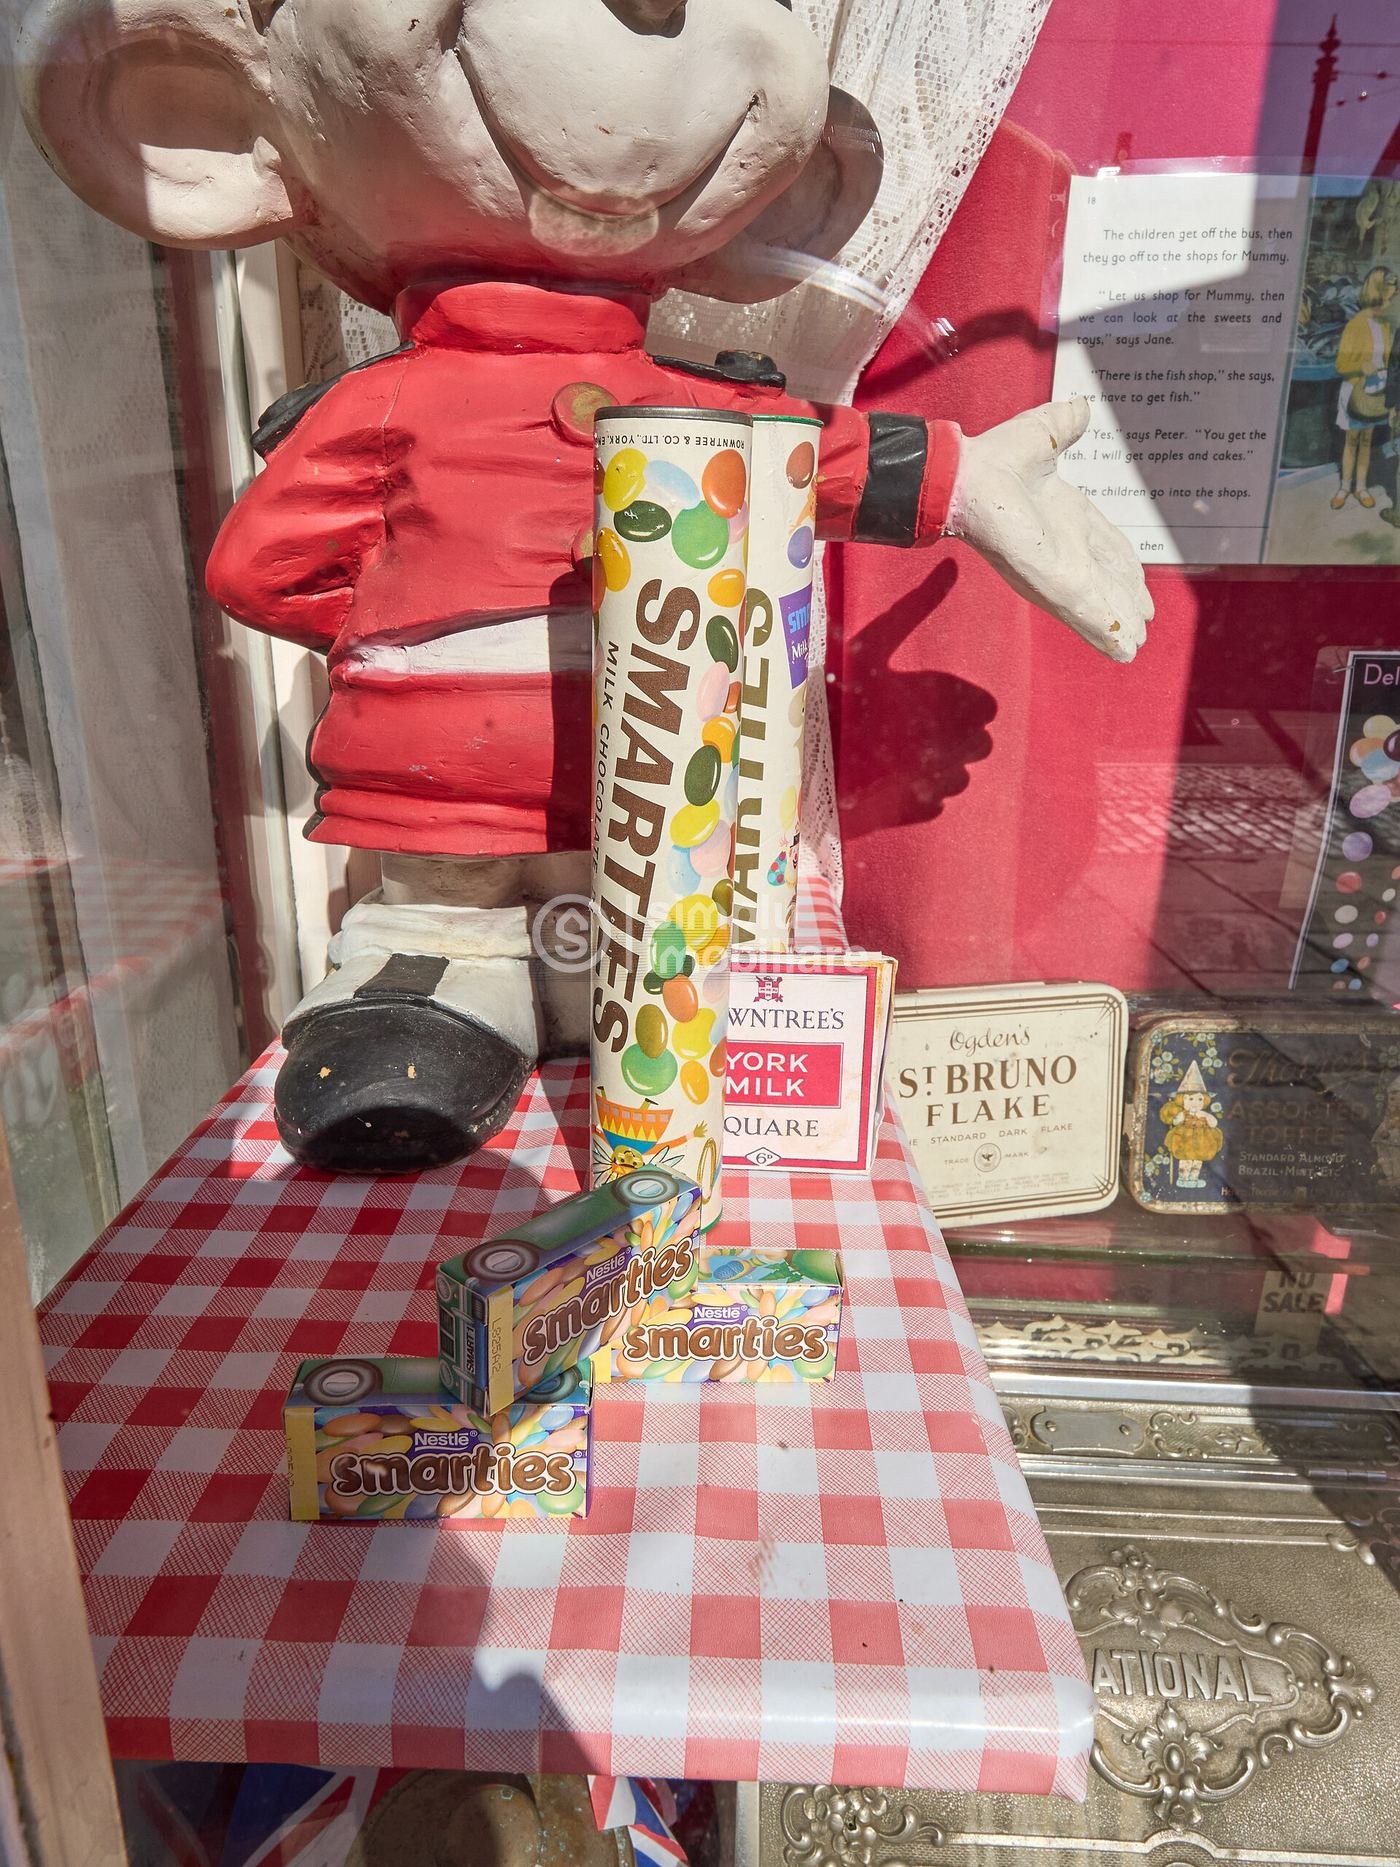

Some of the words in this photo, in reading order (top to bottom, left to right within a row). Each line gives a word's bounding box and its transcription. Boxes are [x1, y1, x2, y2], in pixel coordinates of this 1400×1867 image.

[1104, 230, 1124, 240] The
[1129, 230, 1174, 240] children
[1179, 230, 1197, 241] get
[1202, 228, 1217, 239] off
[1220, 228, 1236, 239] the
[1268, 229, 1292, 239] then
[1084, 253, 1108, 264] they
[1112, 254, 1125, 265] go
[1130, 251, 1145, 262] off
[1147, 253, 1159, 262] to
[1163, 251, 1180, 261] the
[1187, 251, 1218, 264] shops
[1222, 250, 1237, 261] for
[1242, 250, 1289, 265] Mummy.
[1134, 292, 1145, 301] us
[1153, 291, 1179, 304] shop
[1185, 289, 1200, 301] for
[1261, 291, 1285, 301] then
[1079, 314, 1094, 323] we
[1104, 314, 1123, 323] can
[1133, 312, 1157, 323] look
[1167, 313, 1178, 323] at
[1188, 312, 1205, 323] the
[1214, 313, 1251, 323] sweets
[1262, 312, 1282, 323] and
[1116, 337, 1139, 348] says
[1144, 335, 1174, 345] Jane.
[1134, 371, 1142, 381] is
[1146, 370, 1163, 381] the
[1166, 370, 1185, 381] fish
[1227, 371, 1245, 381] she
[1101, 393, 1126, 402] have
[1131, 393, 1142, 402] to
[1147, 394, 1164, 405] get
[661, 434, 680, 445] CO.
[684, 435, 691, 445] &
[695, 436, 745, 450] ROWNTREE
[1127, 431, 1150, 442] says
[1155, 429, 1187, 440] Peter.
[1229, 430, 1246, 442] get
[1250, 429, 1266, 440] the
[1064, 451, 1086, 460] fish.
[1093, 451, 1097, 460] I
[1102, 451, 1121, 460] will
[1125, 452, 1144, 463] get
[1148, 451, 1185, 463] apples
[1188, 451, 1208, 461] and
[1078, 486, 1096, 496] The
[1102, 486, 1146, 497] children
[1151, 489, 1164, 500] go
[1169, 487, 1191, 497] into
[1196, 487, 1213, 497] the
[1218, 487, 1250, 500] shops.
[1140, 541, 1164, 551] then
[603, 640, 620, 710] MILK
[1364, 663, 1400, 686] Del
[592, 578, 702, 1054] SMARTIES
[728, 1008, 845, 1030] WNTREE'S
[949, 1023, 1031, 1057] Ogden's
[727, 1051, 808, 1073] YORK
[946, 1054, 1077, 1095] BRUNO
[726, 1076, 805, 1097] MILK
[926, 1094, 1051, 1127] FLAKE
[724, 1116, 819, 1137] QUARE
[930, 1131, 987, 1145] STANDARD
[999, 1128, 1028, 1138] DARK
[1041, 1122, 1073, 1133] FLAKE
[1005, 1151, 1030, 1159] MARK
[1240, 1151, 1295, 1162] STANDARD
[523, 1237, 693, 1365] smarties
[1263, 1291, 1326, 1314] SALE
[623, 1315, 828, 1361] smarties
[331, 1442, 576, 1496] smarties
[1092, 1649, 1274, 1702] ATIONAL
